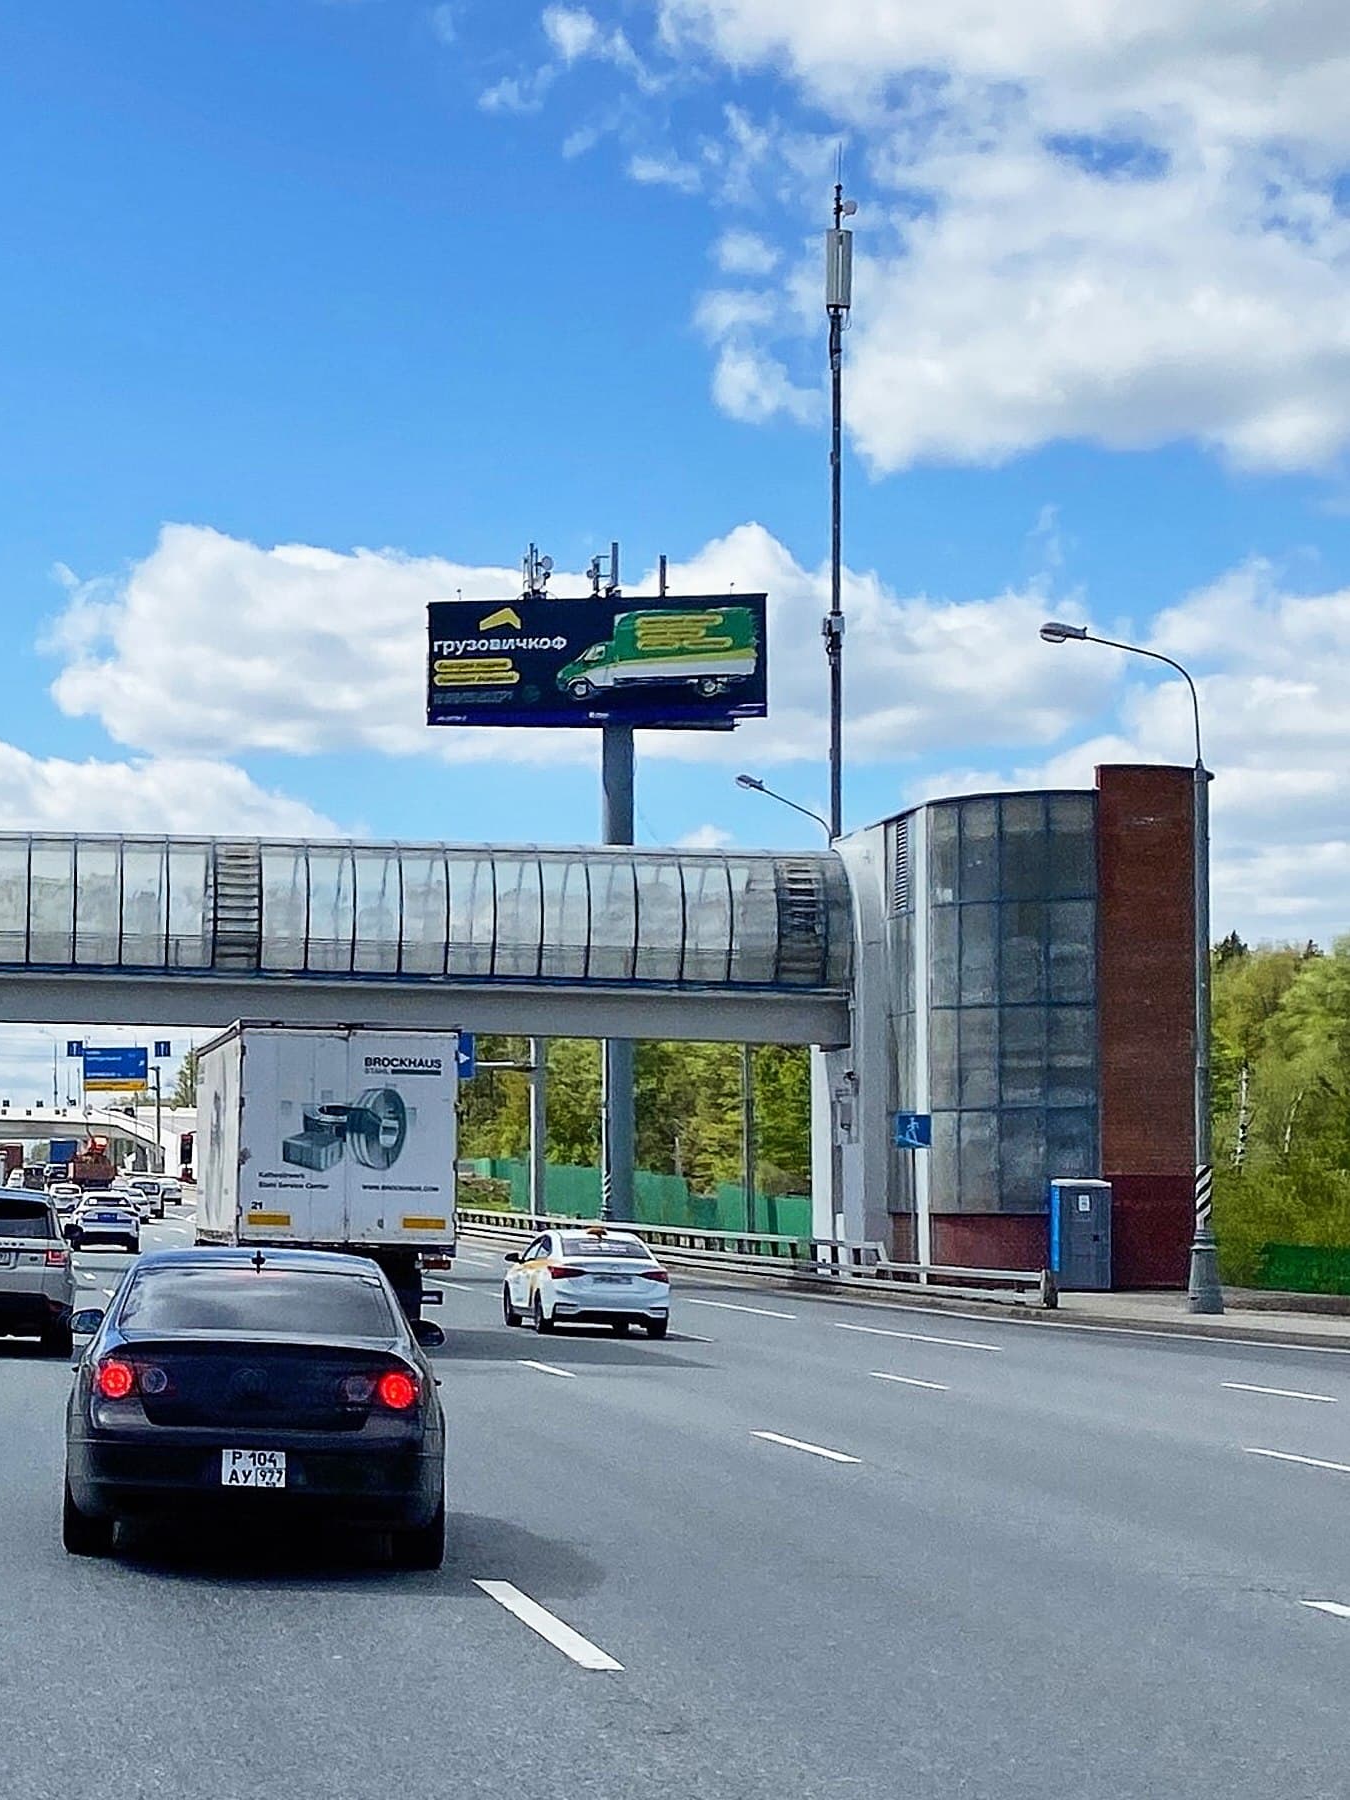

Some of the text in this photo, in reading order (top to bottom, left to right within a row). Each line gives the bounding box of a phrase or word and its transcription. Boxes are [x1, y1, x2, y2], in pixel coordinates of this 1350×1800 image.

[364, 1056, 442, 1068] BROCKHAUS
[251, 1201, 263, 1210] 21
[248, 1452, 277, 1467] 104
